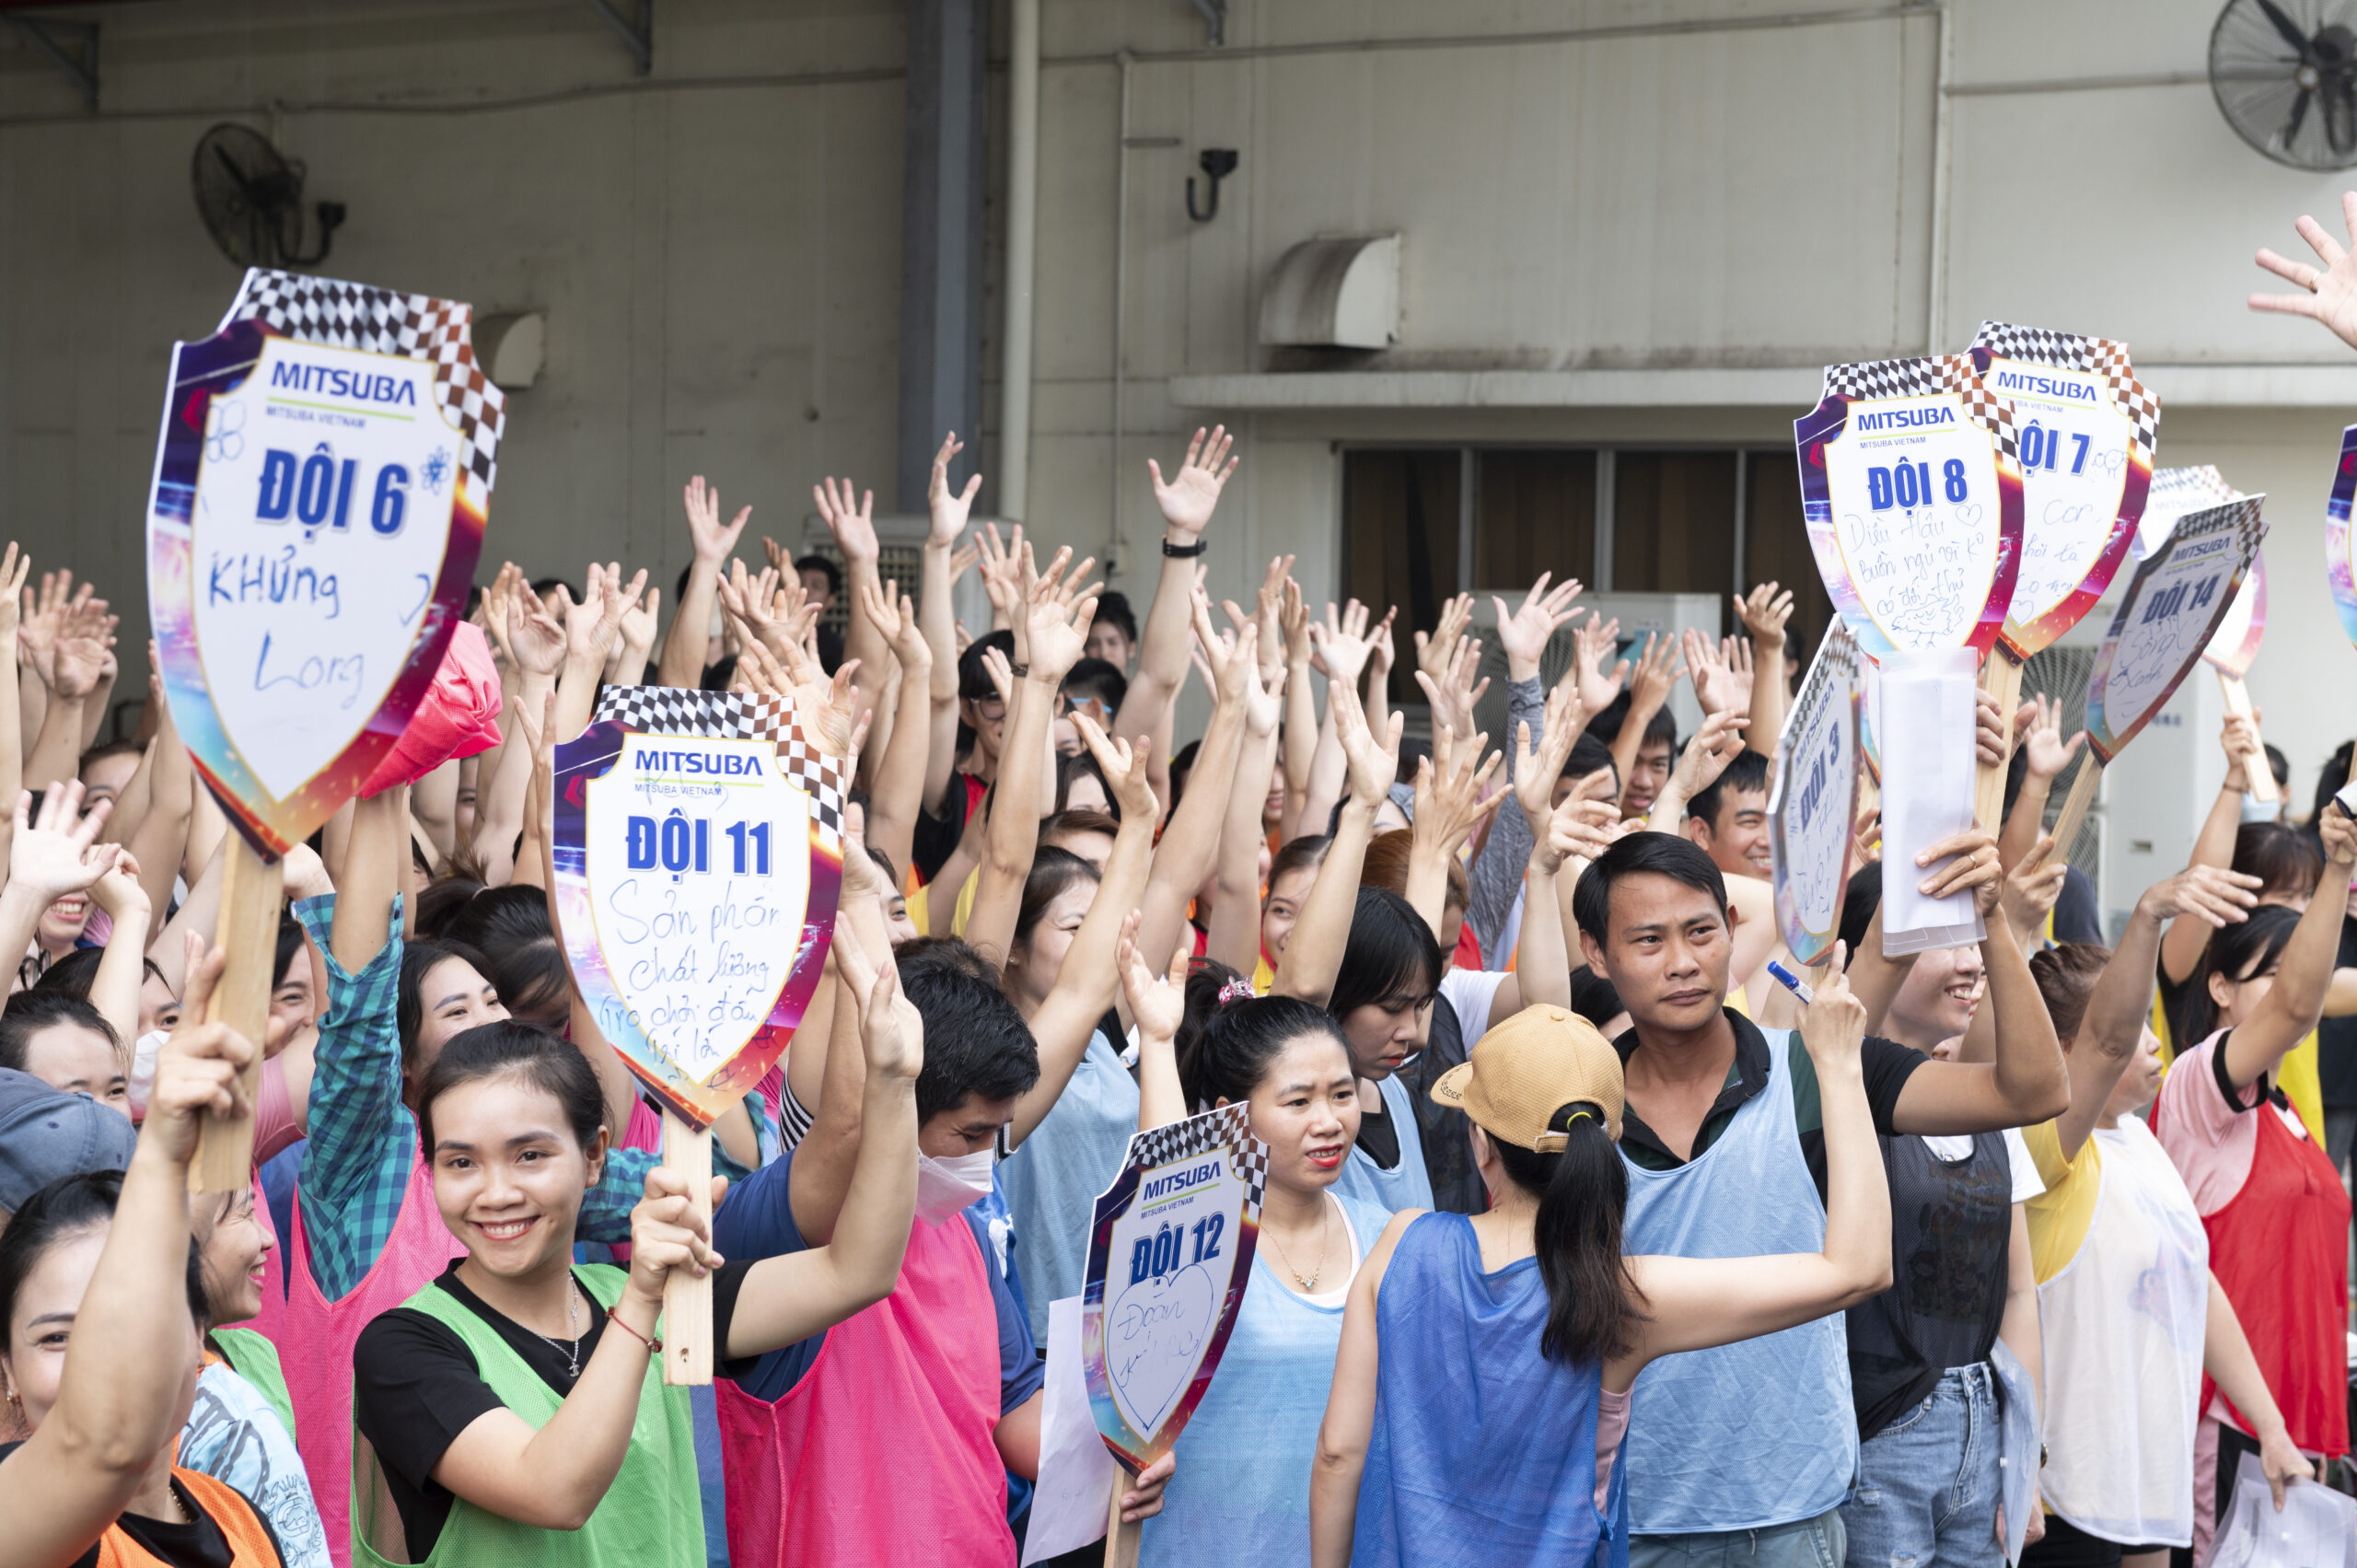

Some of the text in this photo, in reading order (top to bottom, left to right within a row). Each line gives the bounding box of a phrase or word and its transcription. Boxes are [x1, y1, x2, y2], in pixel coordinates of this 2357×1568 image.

[272, 360, 416, 406] MITSUBA
[1998, 372, 2097, 401] MITSUBA
[1858, 406, 1956, 432] MITSUBA
[2030, 402, 2063, 413] VIETNAM
[1860, 436, 1926, 449] MITSUBA VIETNAM
[2020, 419, 2092, 475] ỘI 7
[255, 443, 411, 540] ĐỘI 6
[1868, 457, 1968, 517] ĐỘI 8
[2171, 536, 2231, 563] MITSUBA
[2141, 573, 2223, 624] ĐỘI 14
[1795, 680, 1835, 765] MITSUBA
[635, 749, 764, 777] MITSUBA
[1800, 746, 1827, 833] ĐỘI
[1829, 718, 1840, 768] 3
[634, 783, 723, 796] MITSUBA VIETNAM
[625, 807, 772, 883] ĐỘI 11
[1144, 1161, 1222, 1201] MITSUBA
[1140, 1196, 1194, 1220] MITSUBA VIETNAM
[1128, 1213, 1225, 1285] ĐỘI 12
